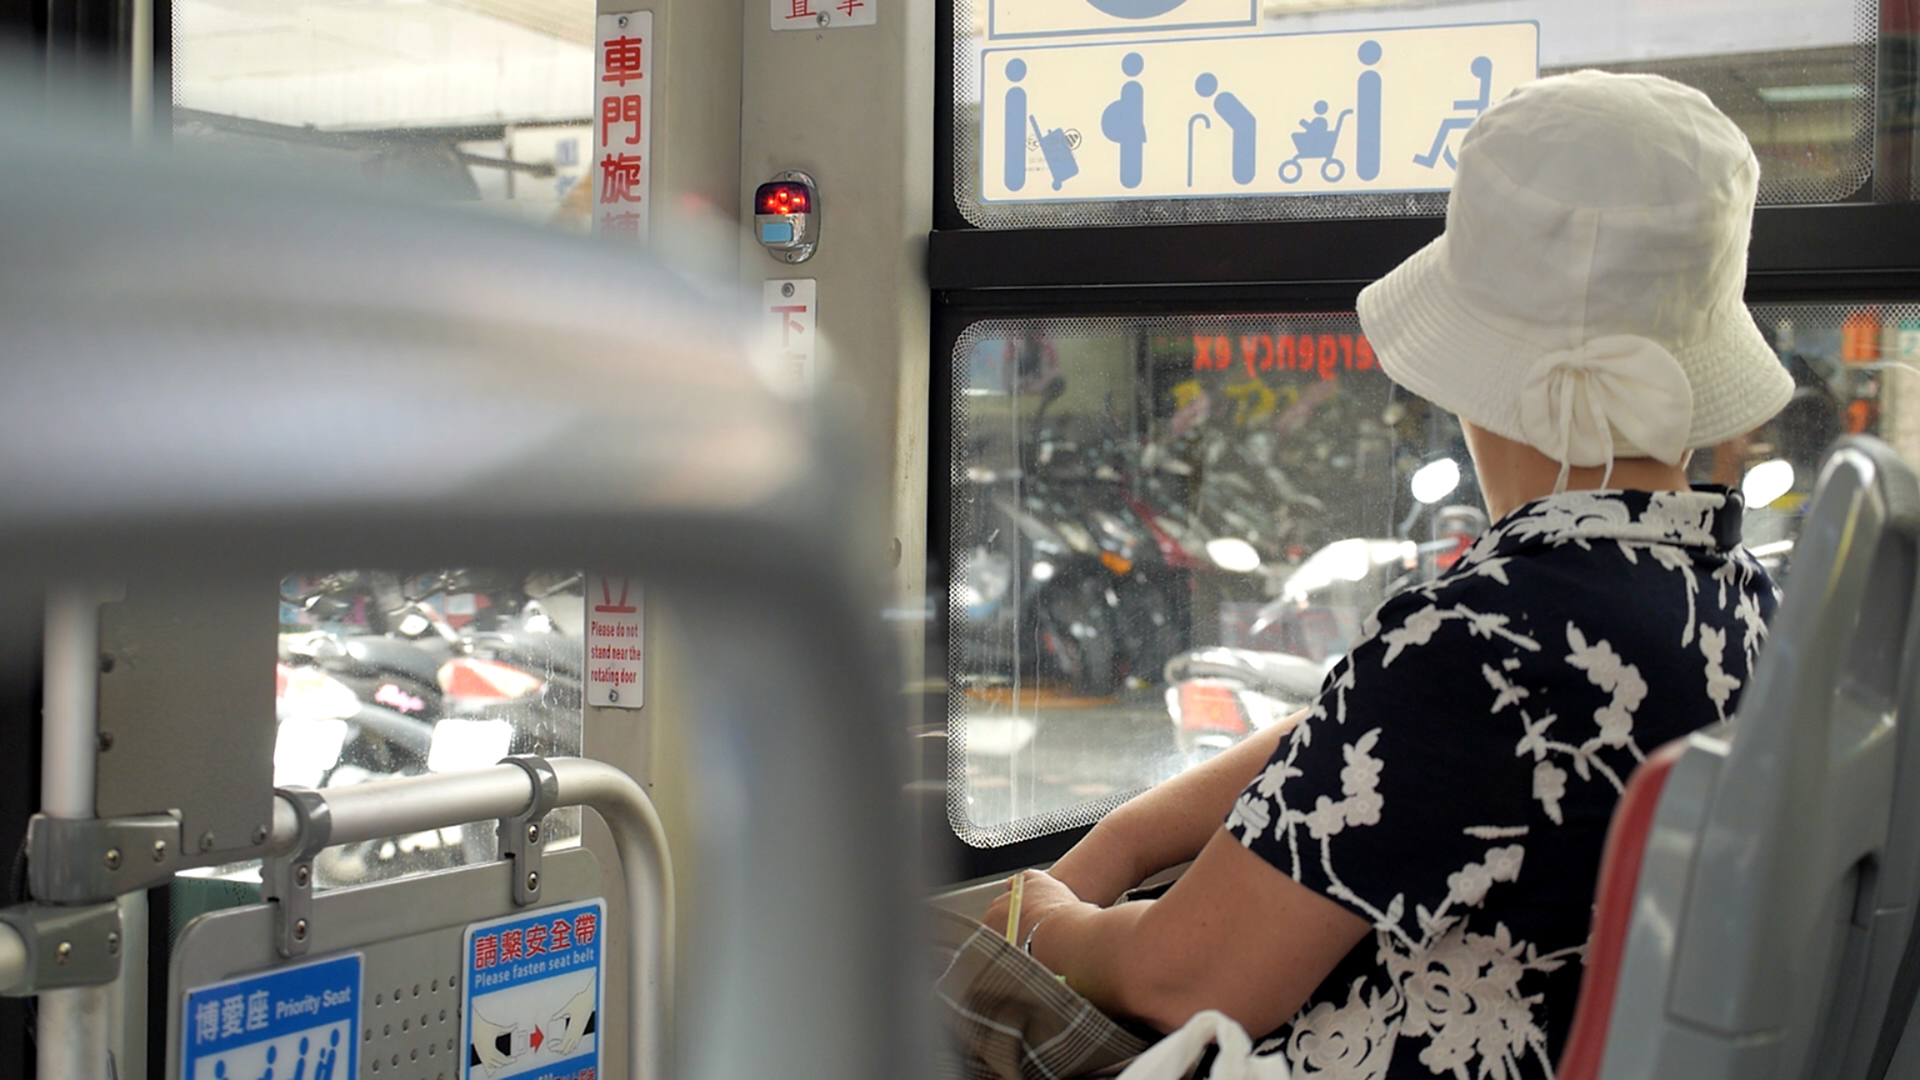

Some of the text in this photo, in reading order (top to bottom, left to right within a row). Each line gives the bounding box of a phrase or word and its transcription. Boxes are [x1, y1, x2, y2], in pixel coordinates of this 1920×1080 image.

[591, 621, 638, 638] Please do not
[591, 645, 641, 661] stand near the
[591, 668, 637, 687] rotating door
[475, 912, 597, 971] 請繫安全帶
[475, 948, 595, 989] Please fasten seat belt
[196, 986, 351, 1045] 博愛座 Priority Seat
